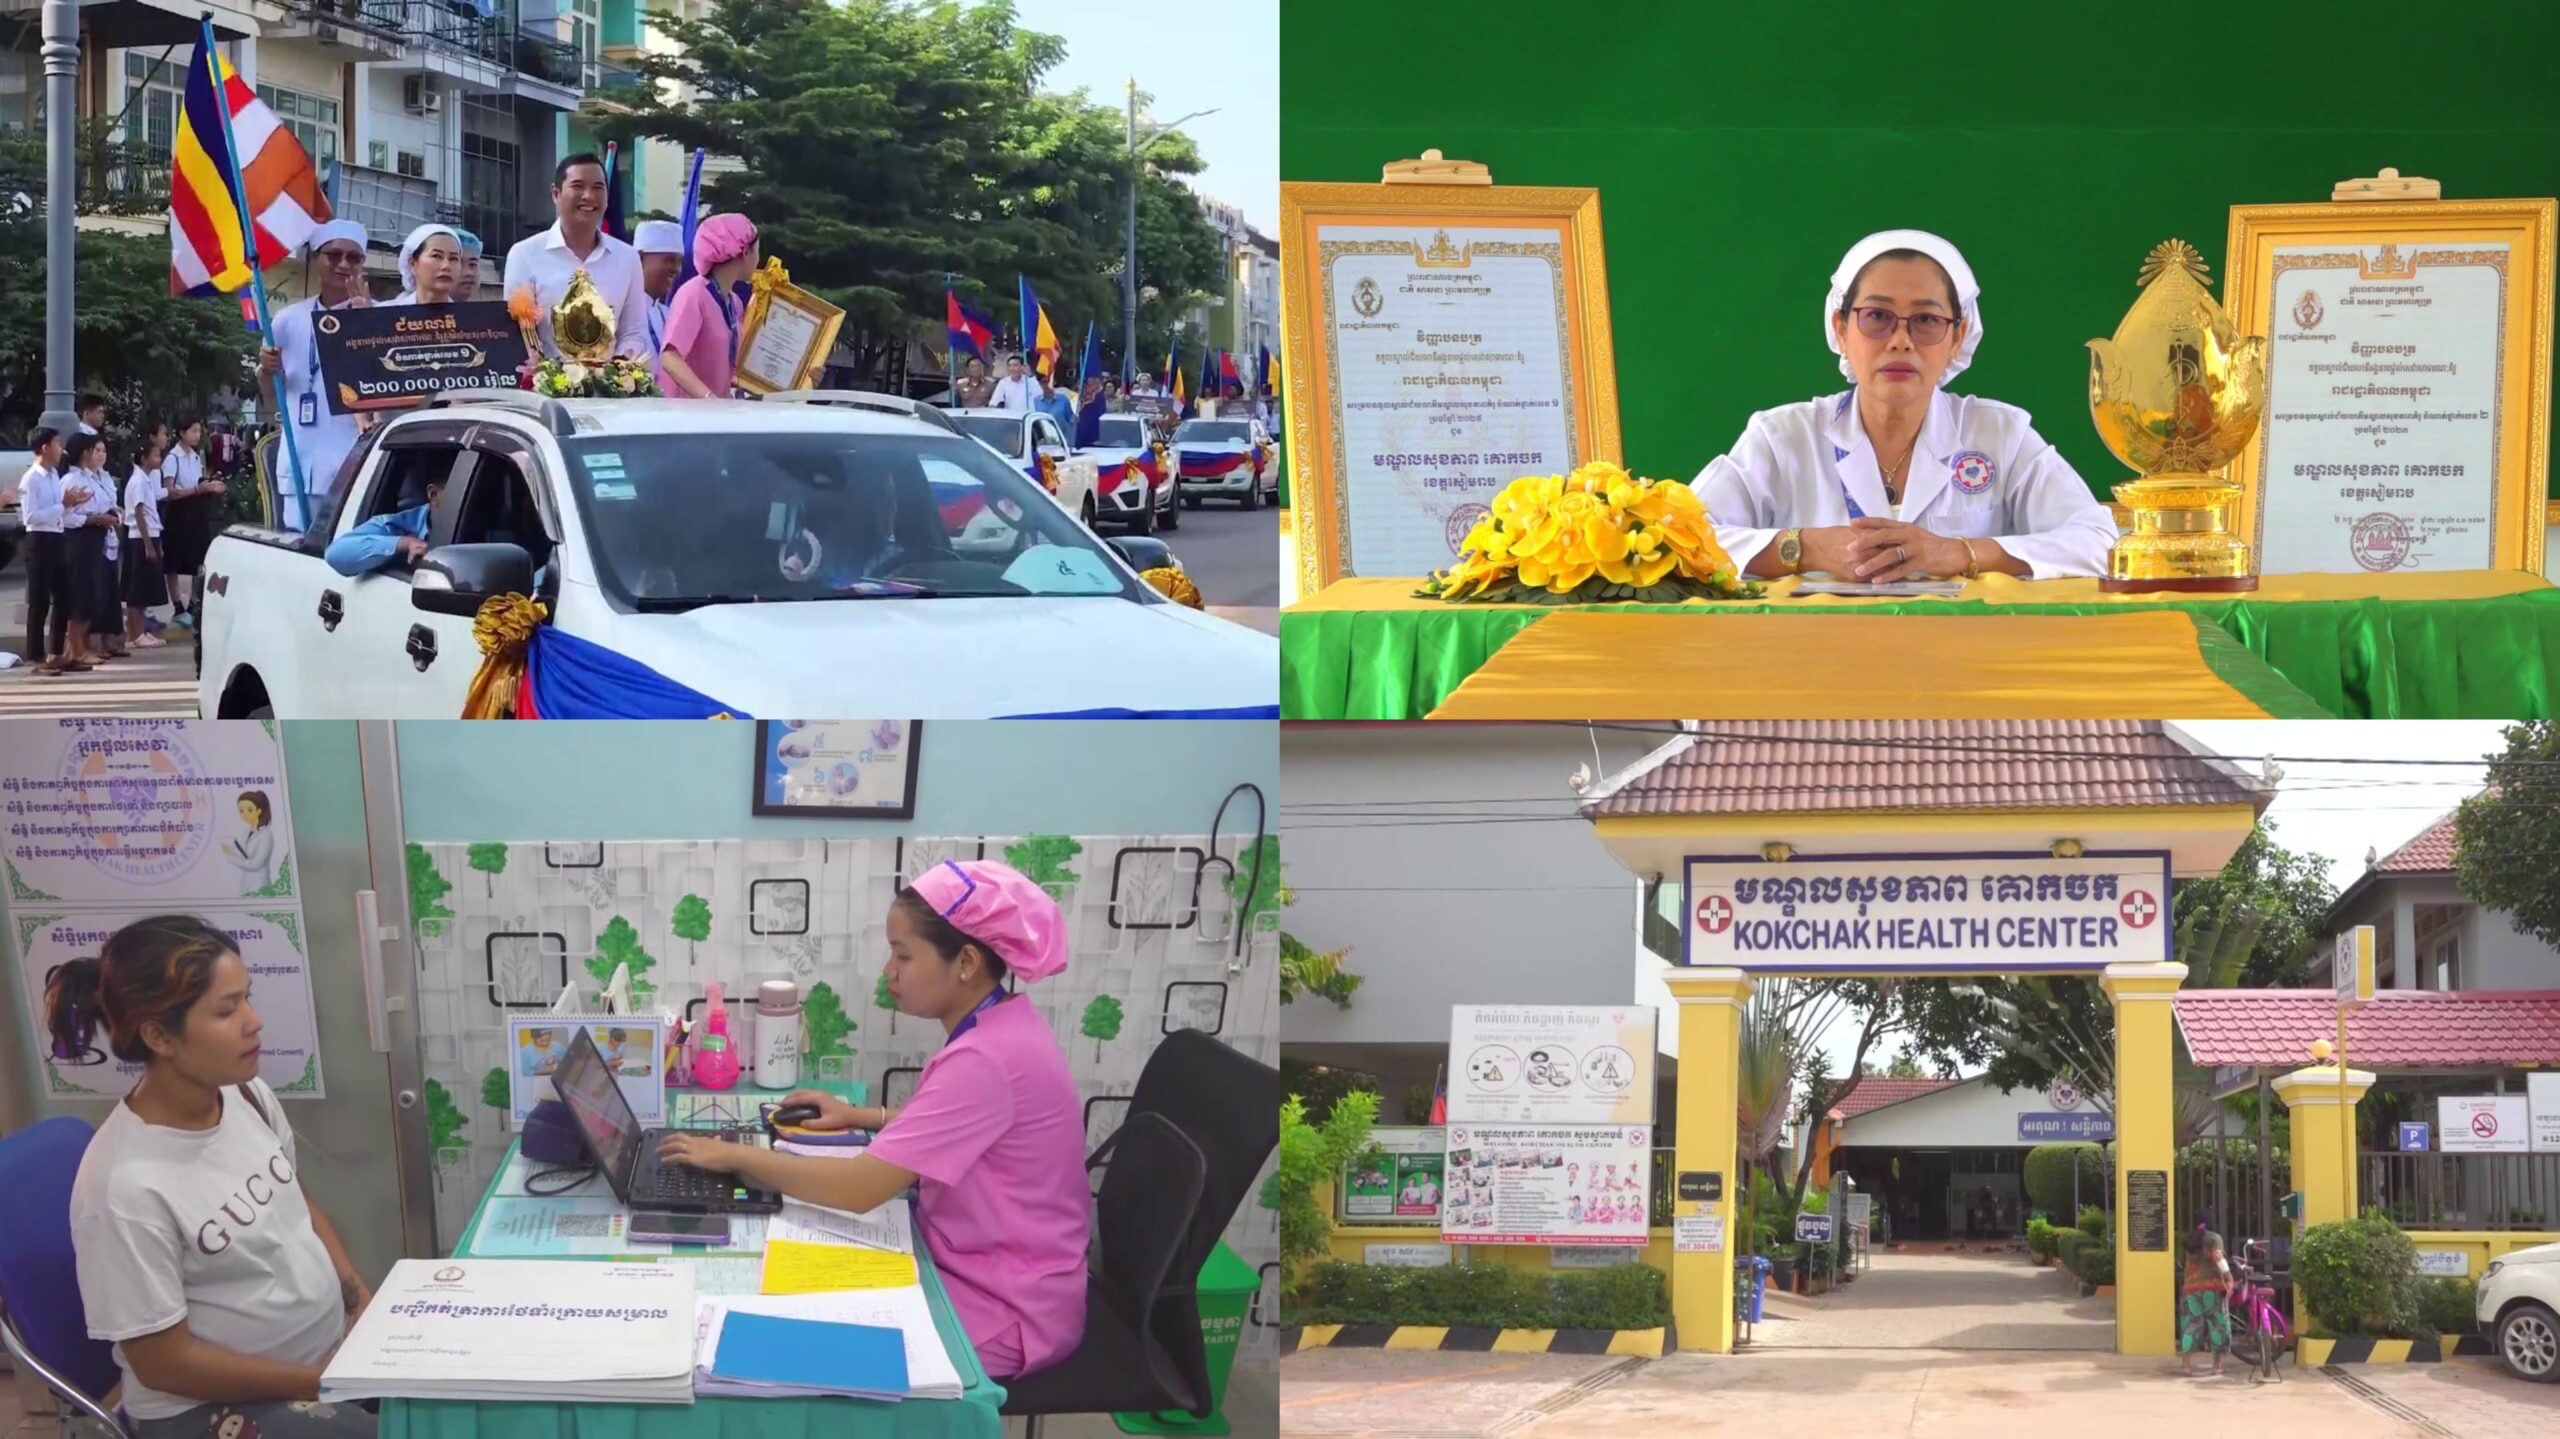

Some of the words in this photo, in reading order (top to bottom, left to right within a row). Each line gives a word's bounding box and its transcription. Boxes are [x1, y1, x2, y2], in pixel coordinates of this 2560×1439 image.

[1373, 452, 1479, 471] មណ្ឌលសុខភាព
[1483, 451, 1543, 465] គោកចក
[2294, 463, 2400, 481] មណ្ឌលសុខភាព
[2404, 463, 2464, 477] គោកចក
[1735, 876, 1967, 918] មណ្ឌលសុខភាព
[1982, 874, 2119, 902] គោកចក
[1734, 919, 1870, 950] KOKCHAK
[1878, 918, 1989, 949] HEALTH
[2000, 917, 2118, 948] CENTER
[2410, 1130, 2418, 1141] P
[197, 1146, 293, 1255] GUCC
